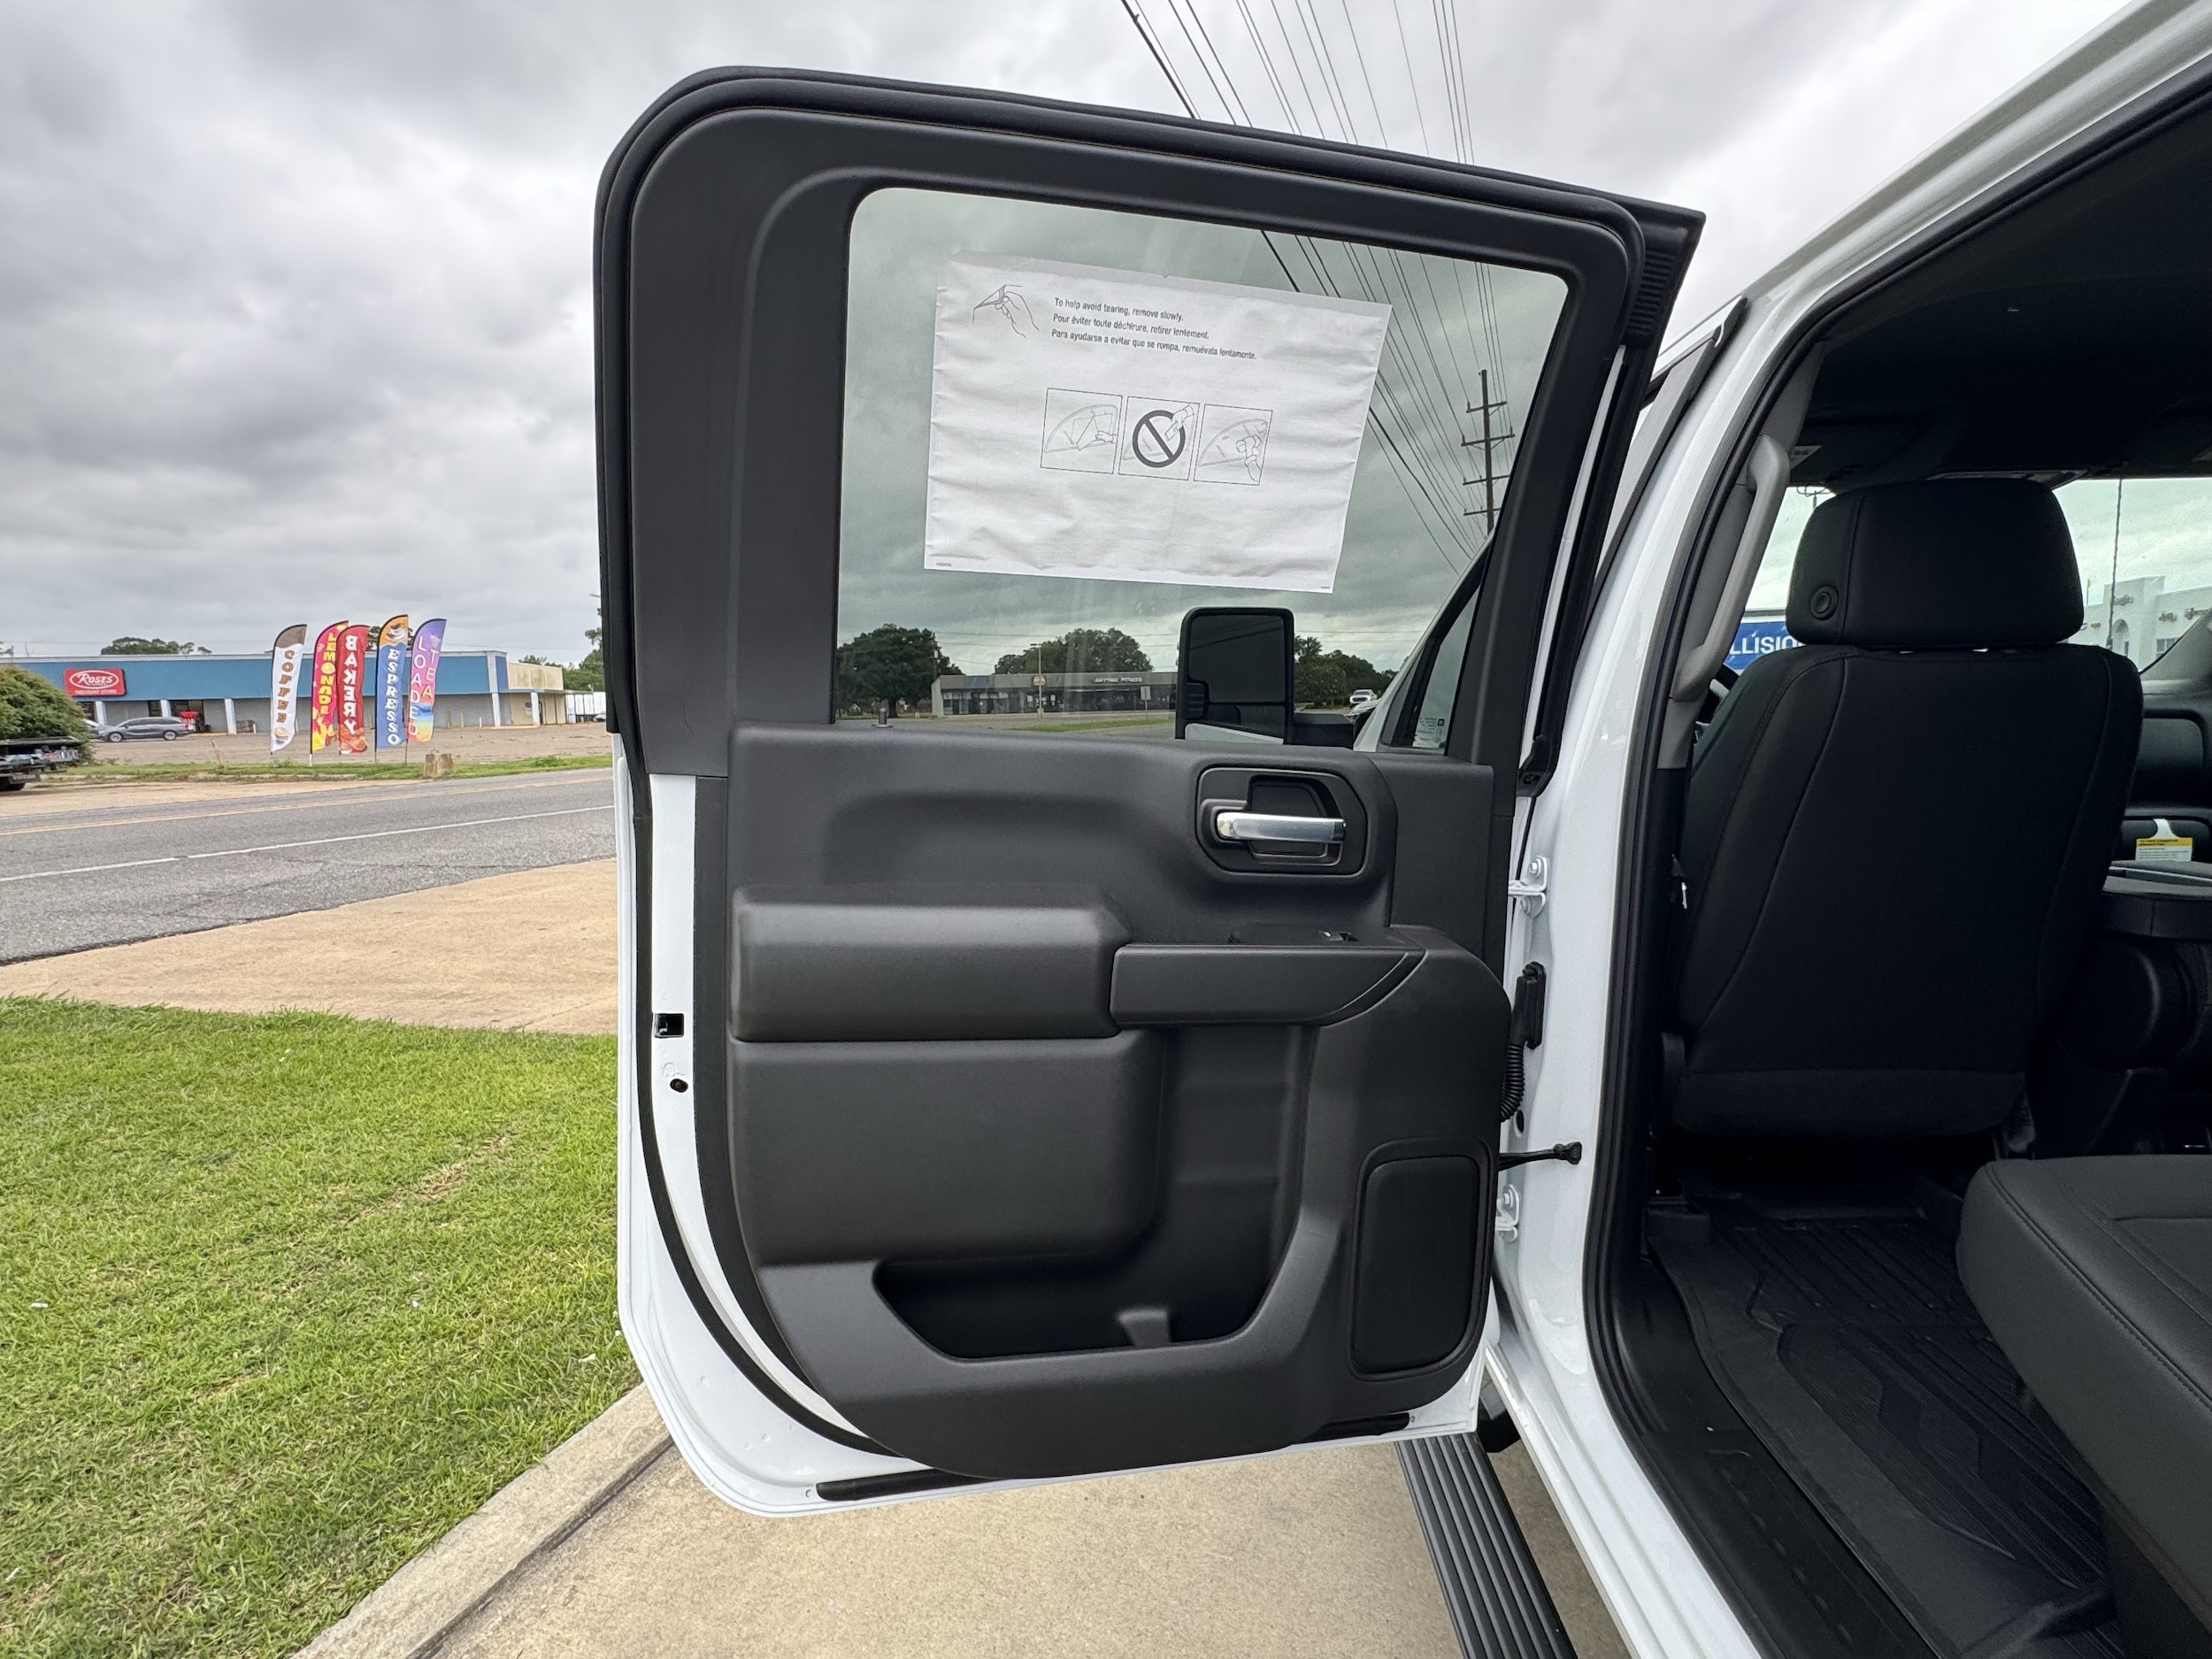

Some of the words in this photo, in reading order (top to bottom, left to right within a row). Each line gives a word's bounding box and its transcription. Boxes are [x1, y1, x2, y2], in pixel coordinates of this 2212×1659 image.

[1053, 313, 1070, 323] Pour
[1071, 315, 1091, 326] éviter
[1094, 318, 1111, 328] toute
[1150, 325, 1172, 335] retirer
[1055, 297, 1064, 307] To
[1064, 299, 1080, 310] help
[1082, 302, 1102, 311] avoid
[1103, 303, 1130, 316] tearing,
[1133, 308, 1158, 318] remove
[1051, 328, 1068, 339] Para
[1070, 332, 1102, 343] ayudarse
[1110, 335, 1131, 346] evitar
[1133, 339, 1145, 348] que
[1156, 342, 1180, 352] rompa,
[1729, 634, 1800, 655] LLISIO
[277, 649, 296, 723] COFFEE
[319, 632, 336, 715] LEMONADE
[385, 648, 401, 746] ESPRESSO
[408, 635, 426, 735] LOADED
[422, 648, 439, 700] TEA
